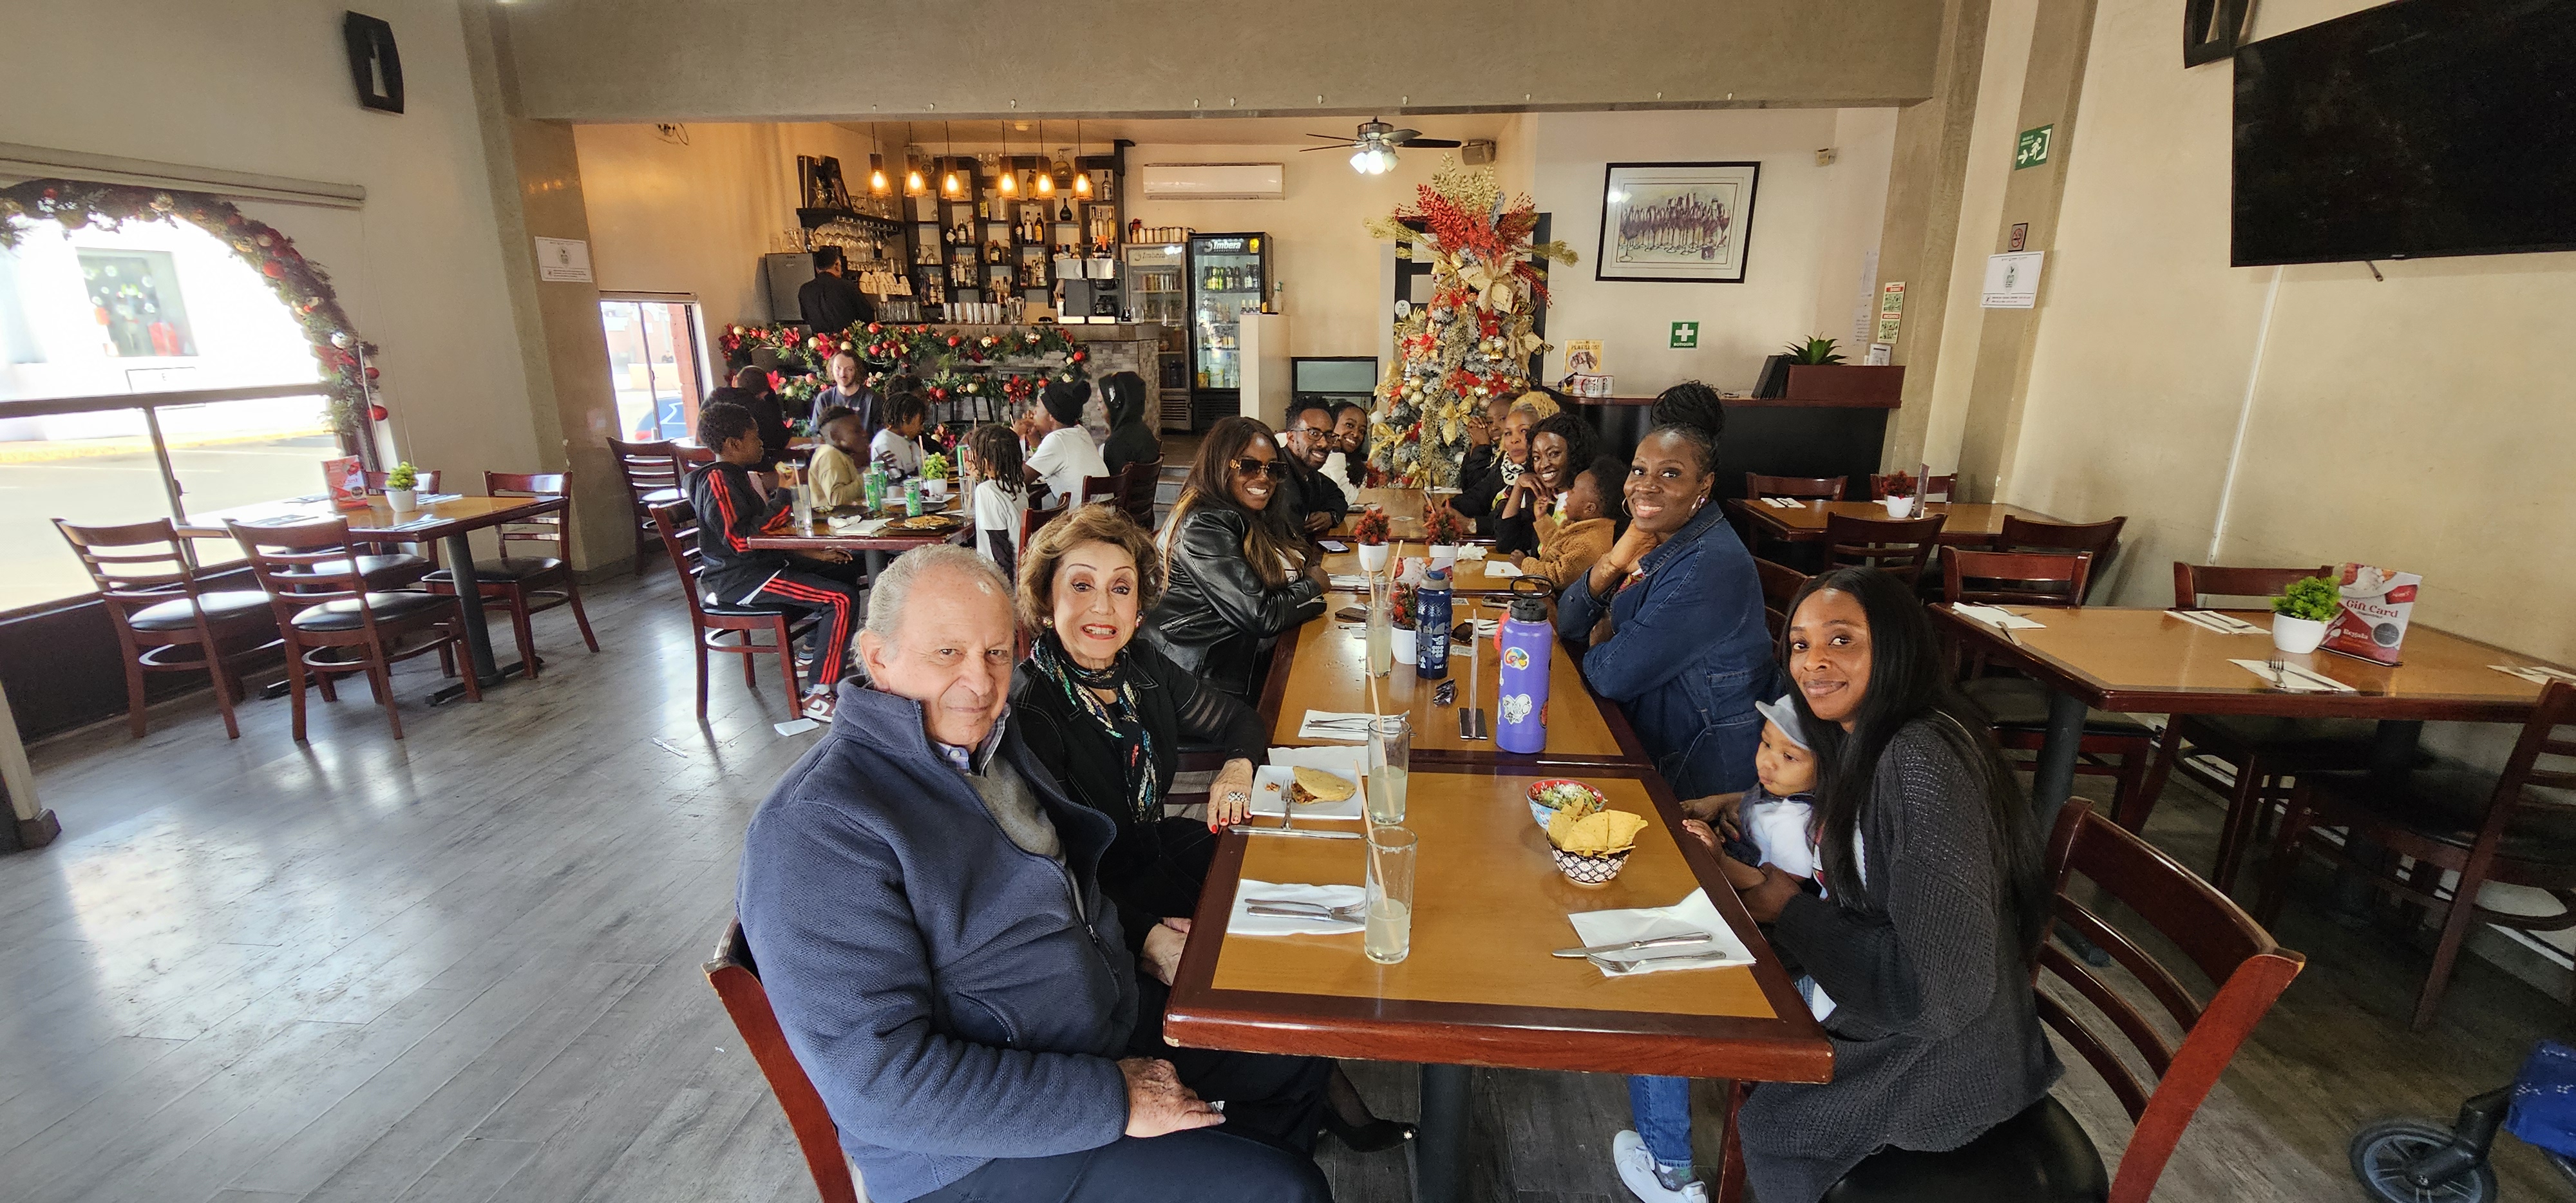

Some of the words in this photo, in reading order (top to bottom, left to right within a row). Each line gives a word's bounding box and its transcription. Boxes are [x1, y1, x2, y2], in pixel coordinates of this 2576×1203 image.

[1213, 241, 1241, 249] Imbera
[2346, 600, 2367, 611] Gift
[2369, 604, 2398, 618] Card
[2343, 629, 2369, 639] Regala
